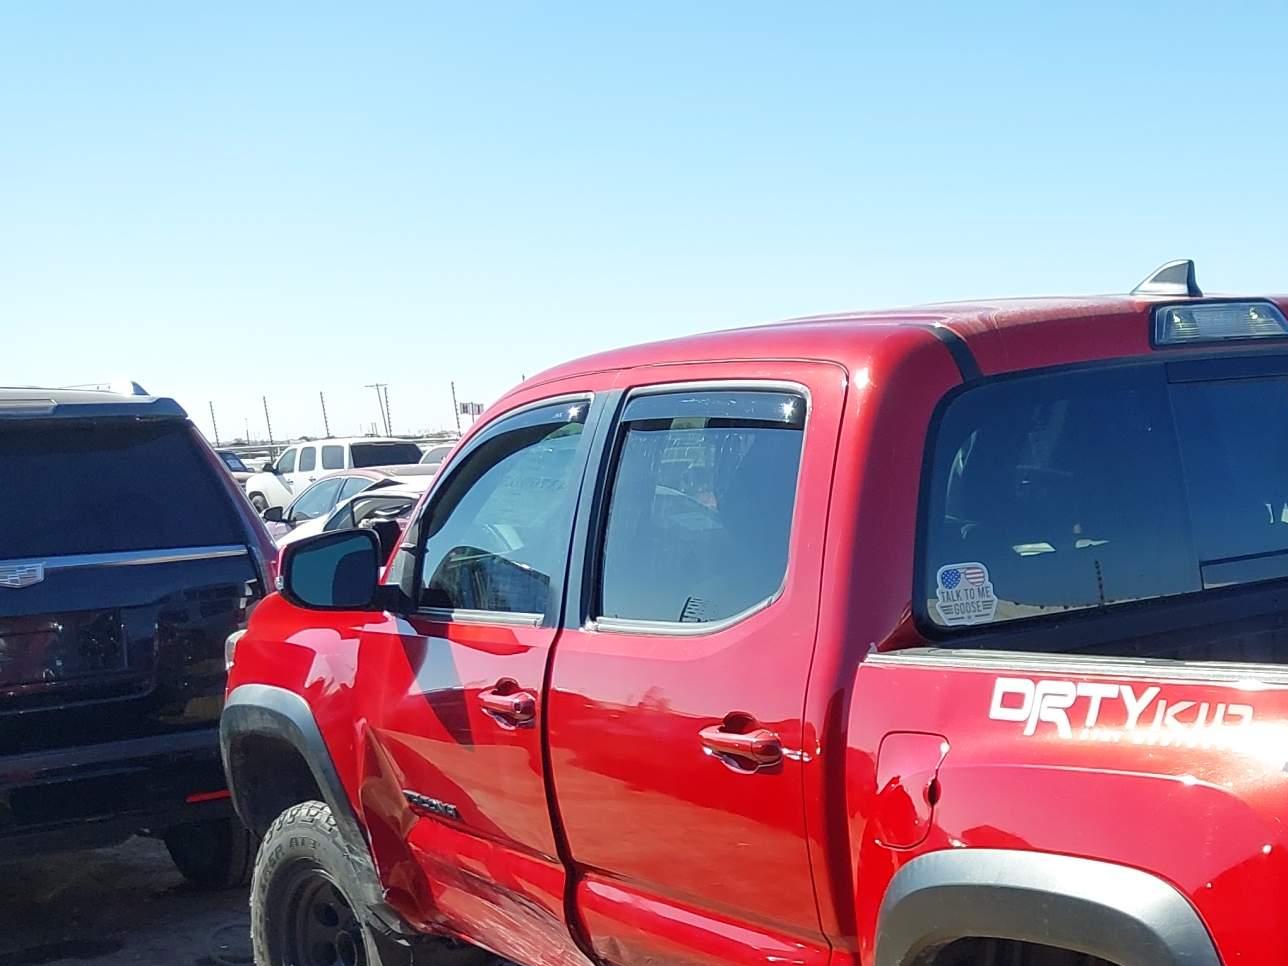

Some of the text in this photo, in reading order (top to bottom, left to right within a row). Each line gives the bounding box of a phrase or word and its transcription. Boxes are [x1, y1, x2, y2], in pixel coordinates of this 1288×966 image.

[941, 586, 991, 602] TALK TO ME
[953, 601, 983, 615] GOOSE
